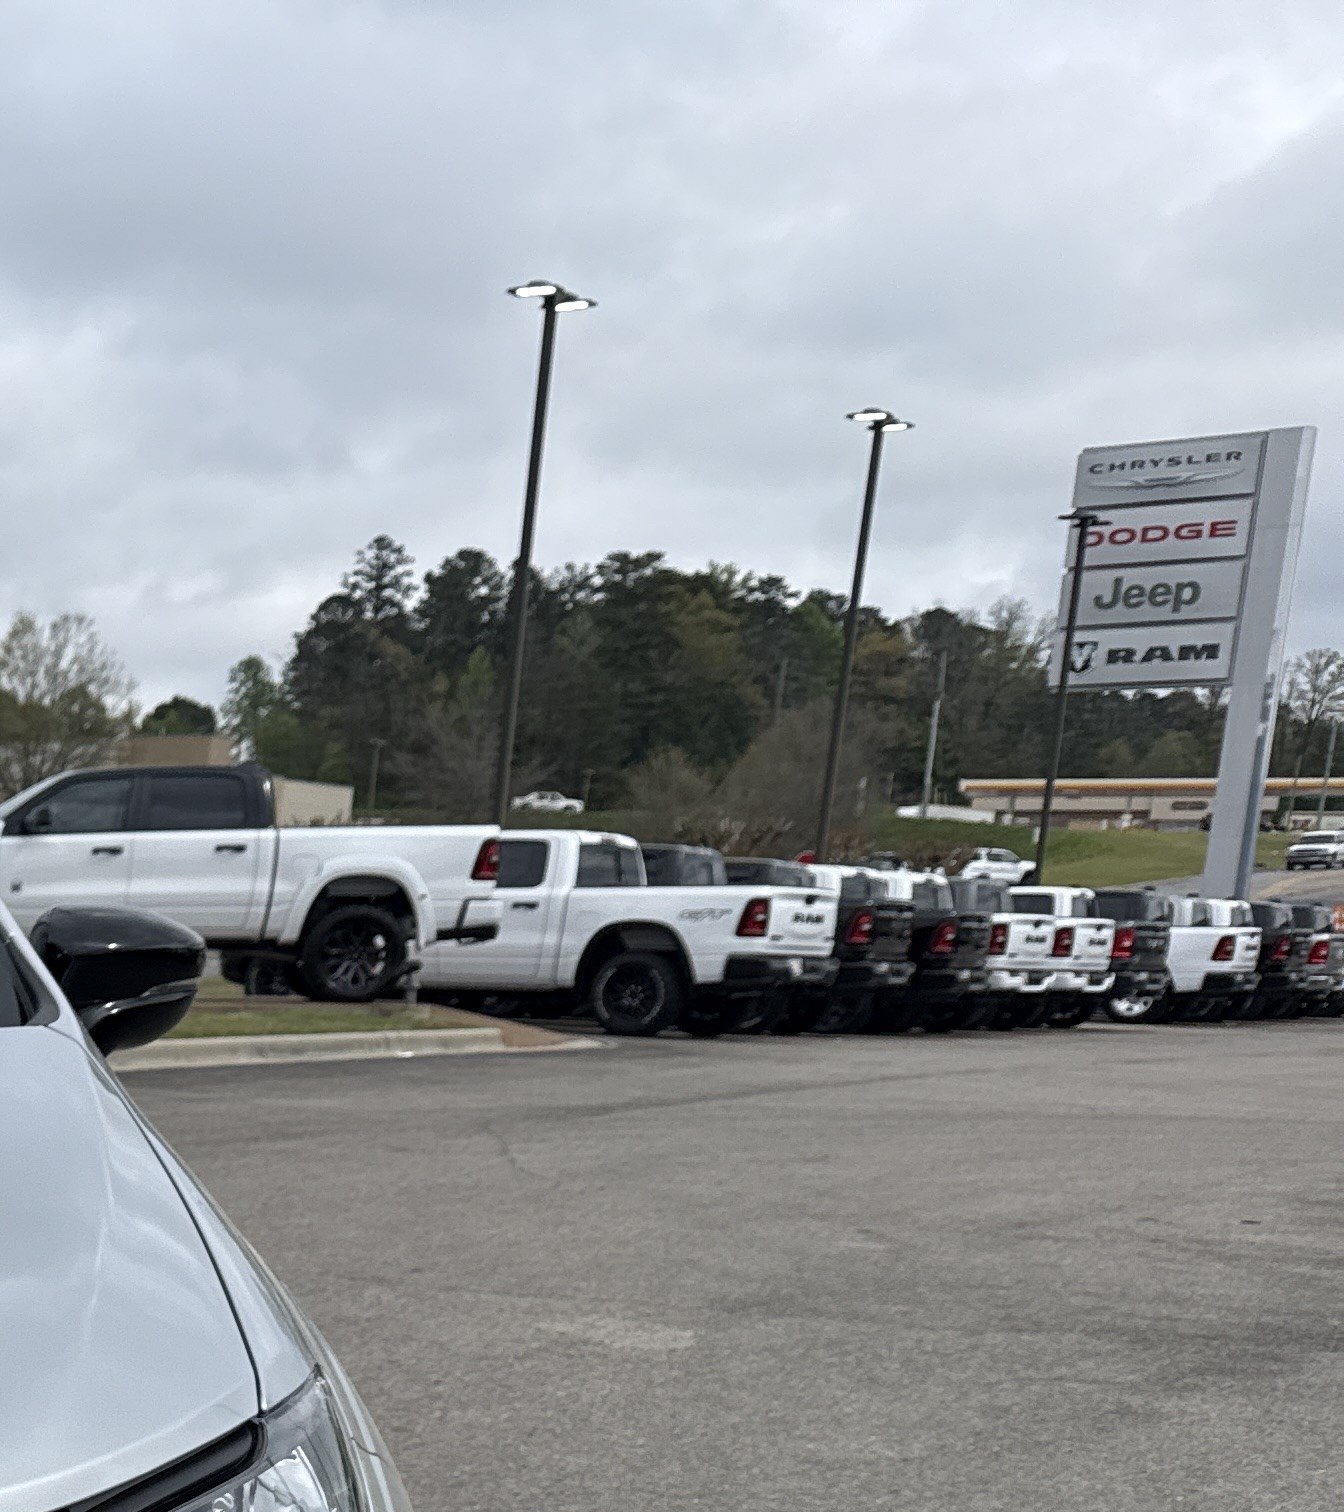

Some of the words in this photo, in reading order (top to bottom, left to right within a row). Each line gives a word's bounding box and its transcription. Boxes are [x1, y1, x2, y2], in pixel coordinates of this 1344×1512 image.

[1088, 450, 1243, 475] CHRYSLER
[1092, 576, 1202, 614] Jeep
[1106, 643, 1220, 666] RAM
